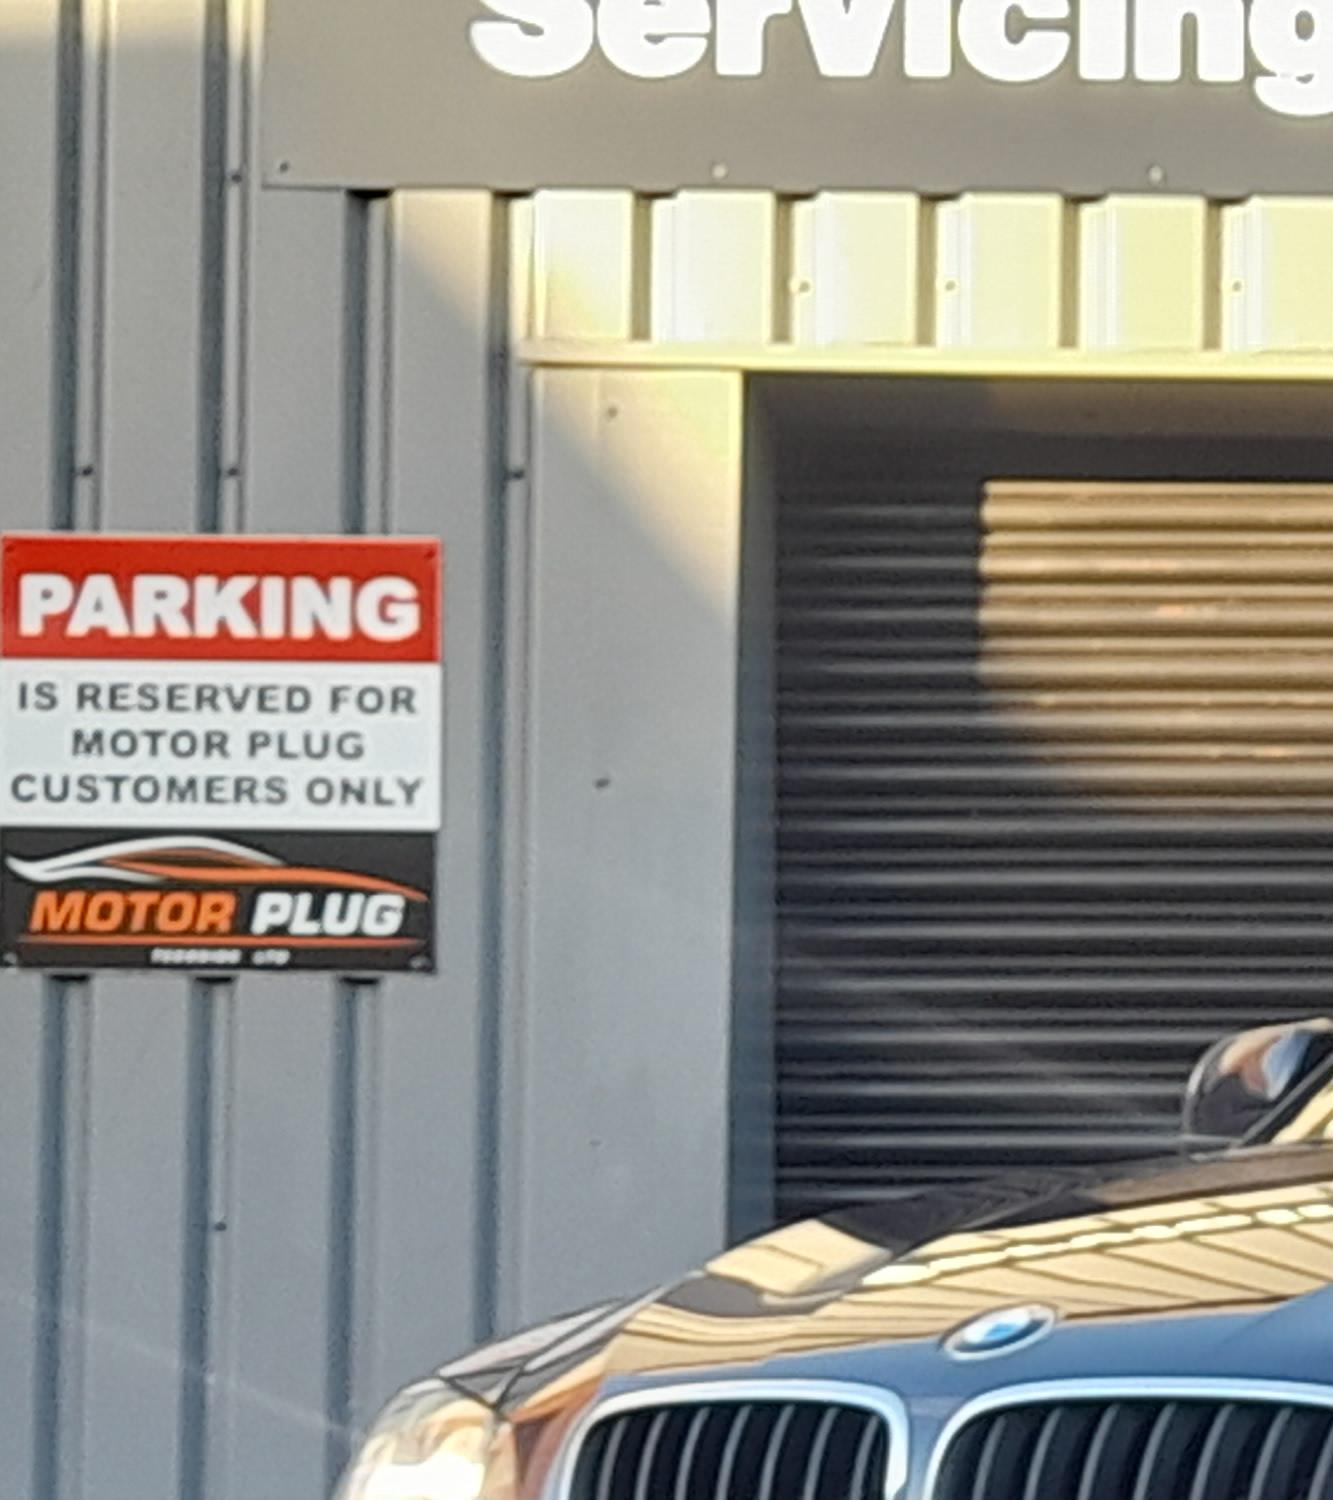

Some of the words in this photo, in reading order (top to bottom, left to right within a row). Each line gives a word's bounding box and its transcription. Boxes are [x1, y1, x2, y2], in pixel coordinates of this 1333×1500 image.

[19, 573, 421, 641] PARKING
[18, 682, 59, 712] IS
[76, 683, 312, 714] RESERVED
[331, 685, 417, 715] FOR
[72, 729, 230, 759] MOTOR
[248, 731, 365, 760] PLUG
[11, 774, 288, 804] CUSTOMERS
[306, 776, 423, 806] ONLY
[30, 890, 237, 933] MOTOR
[250, 891, 405, 936] PLUG
